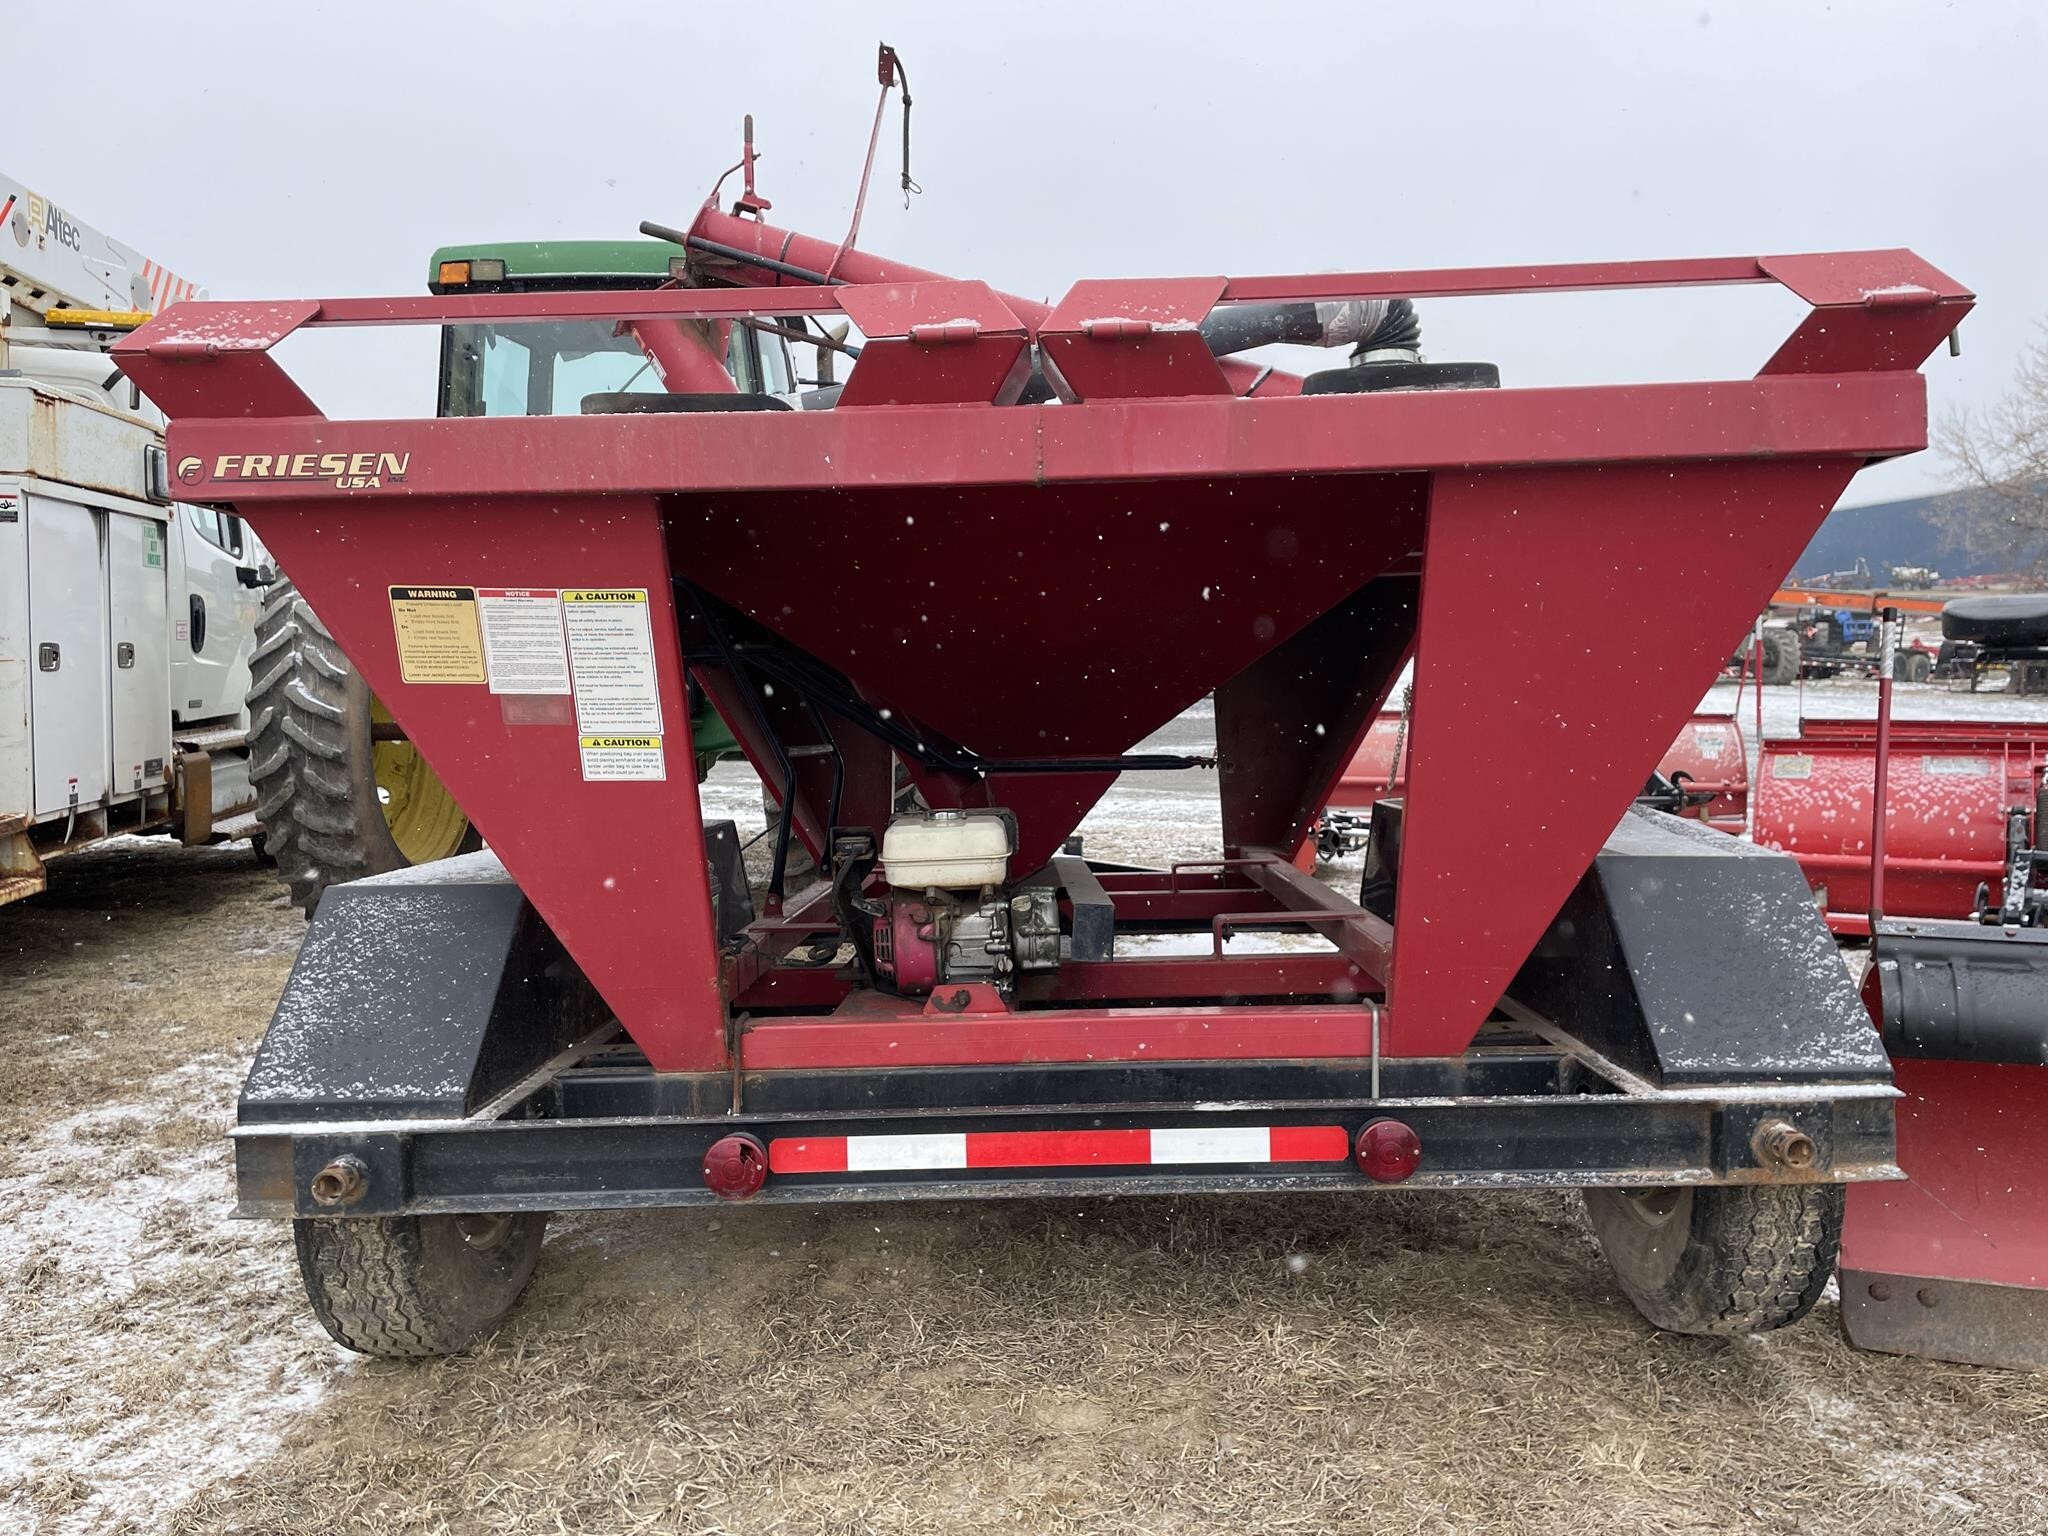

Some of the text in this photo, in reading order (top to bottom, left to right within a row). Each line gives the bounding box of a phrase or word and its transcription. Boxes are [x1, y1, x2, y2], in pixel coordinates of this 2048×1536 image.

[45, 204, 81, 252] Altec
[213, 452, 411, 478] FRIESEN
[335, 476, 382, 489] USA
[408, 590, 457, 598] WARNING
